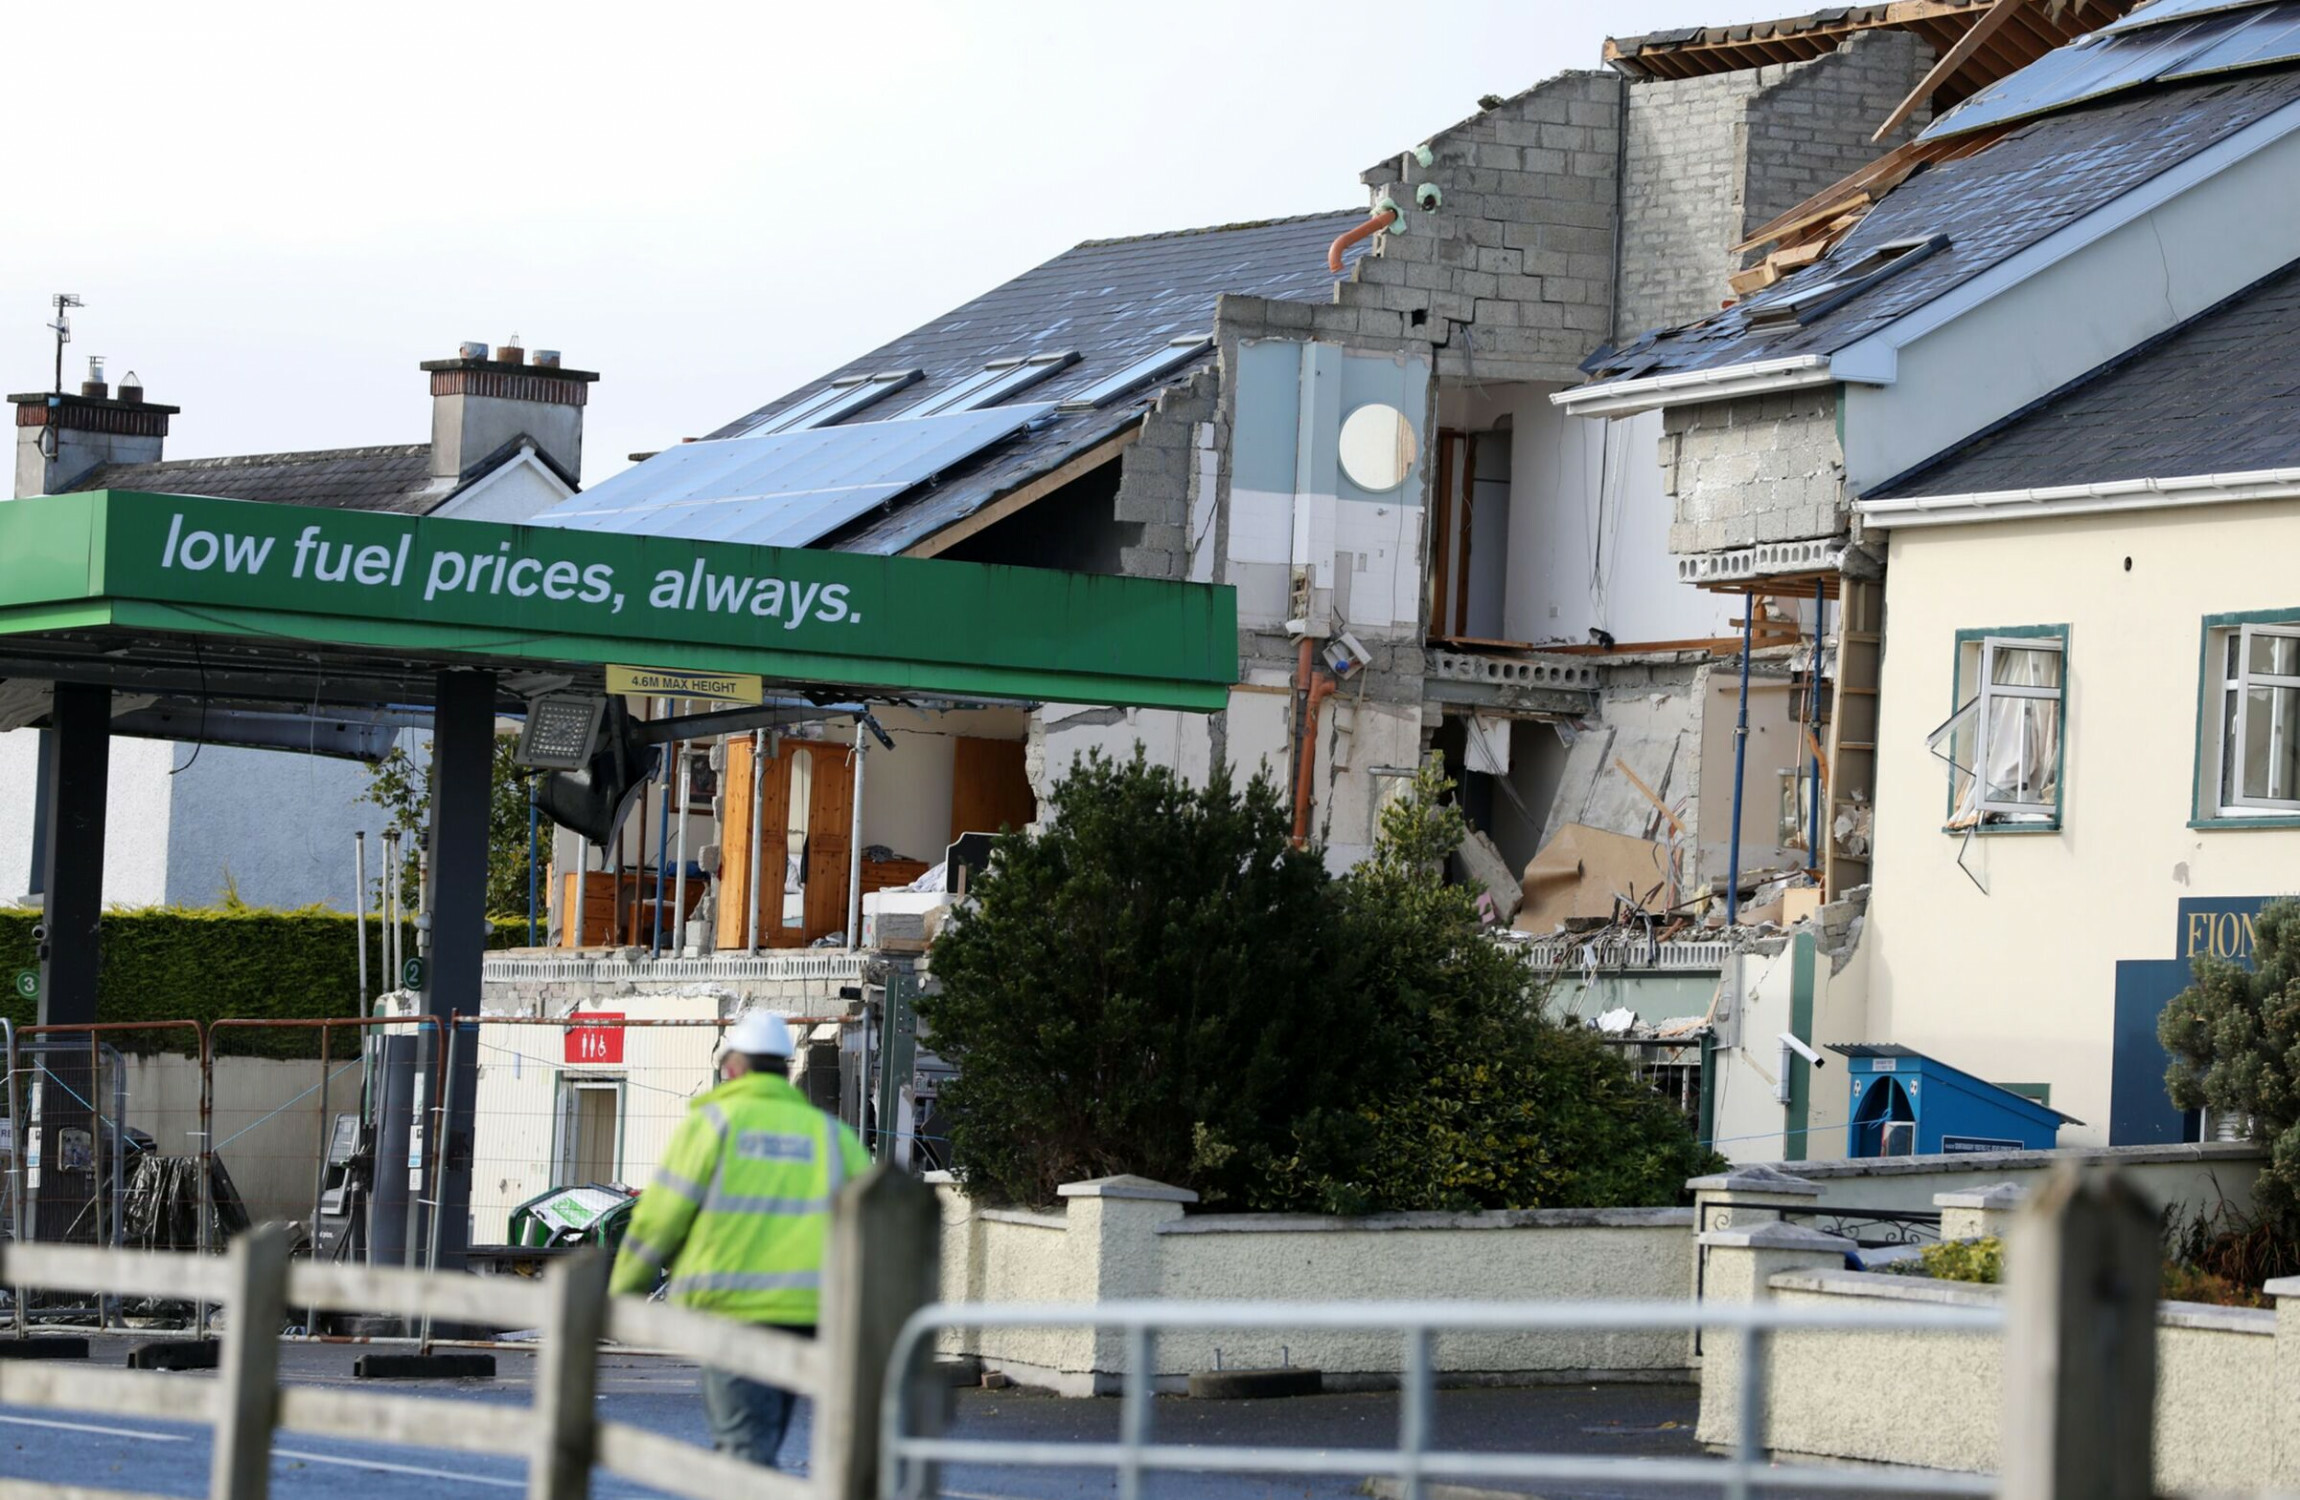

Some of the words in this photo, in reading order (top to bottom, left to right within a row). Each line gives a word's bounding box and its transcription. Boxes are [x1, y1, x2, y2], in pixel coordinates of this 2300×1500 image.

[162, 514, 275, 574] low
[292, 526, 411, 586] fuel
[425, 541, 625, 614] prices,
[649, 558, 861, 629] always.
[631, 675, 659, 688] 4.6M
[662, 677, 689, 690] MAX
[691, 680, 737, 694] HEIGHT
[409, 964, 419, 982] 2
[24, 976, 35, 991] 3
